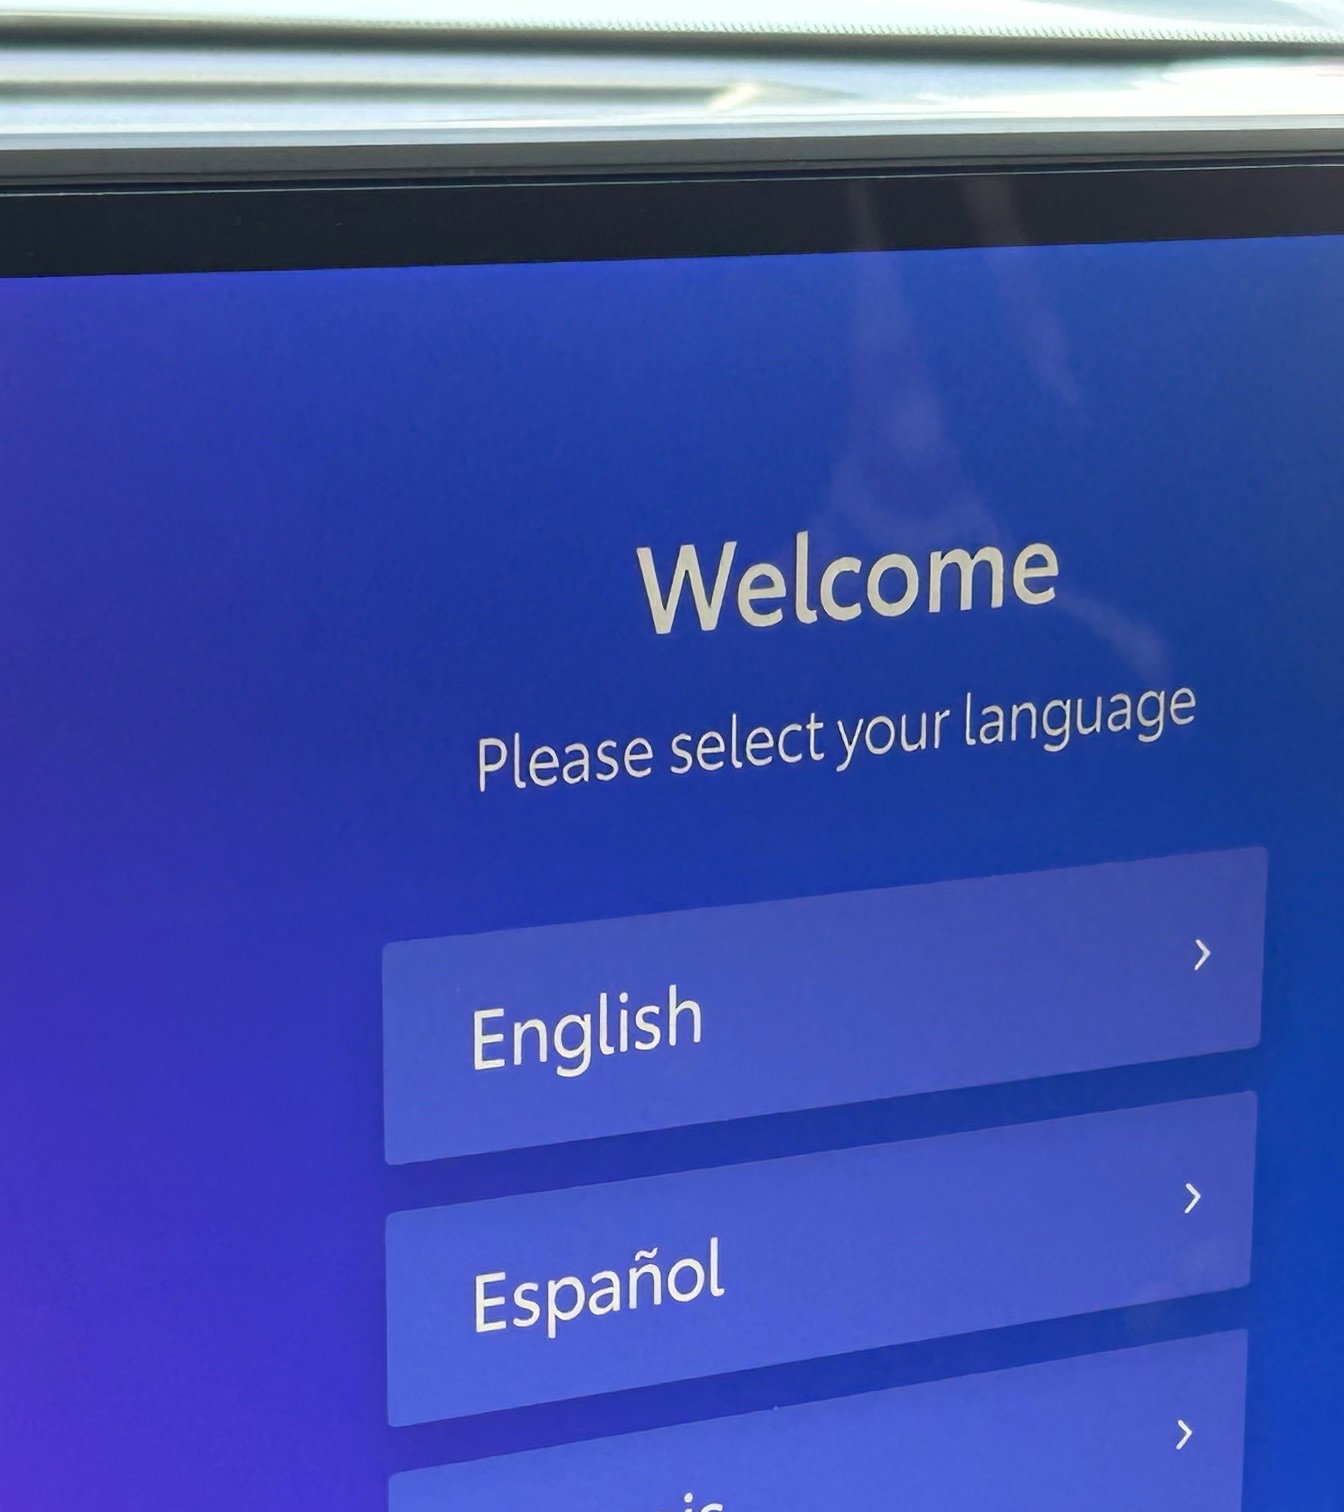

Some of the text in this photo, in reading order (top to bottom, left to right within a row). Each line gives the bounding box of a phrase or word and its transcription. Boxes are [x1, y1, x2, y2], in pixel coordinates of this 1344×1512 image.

[636, 530, 1059, 635] Welcome
[477, 687, 1197, 792] Please select your language
[472, 984, 702, 1078] English
[473, 1237, 725, 1338] Español
